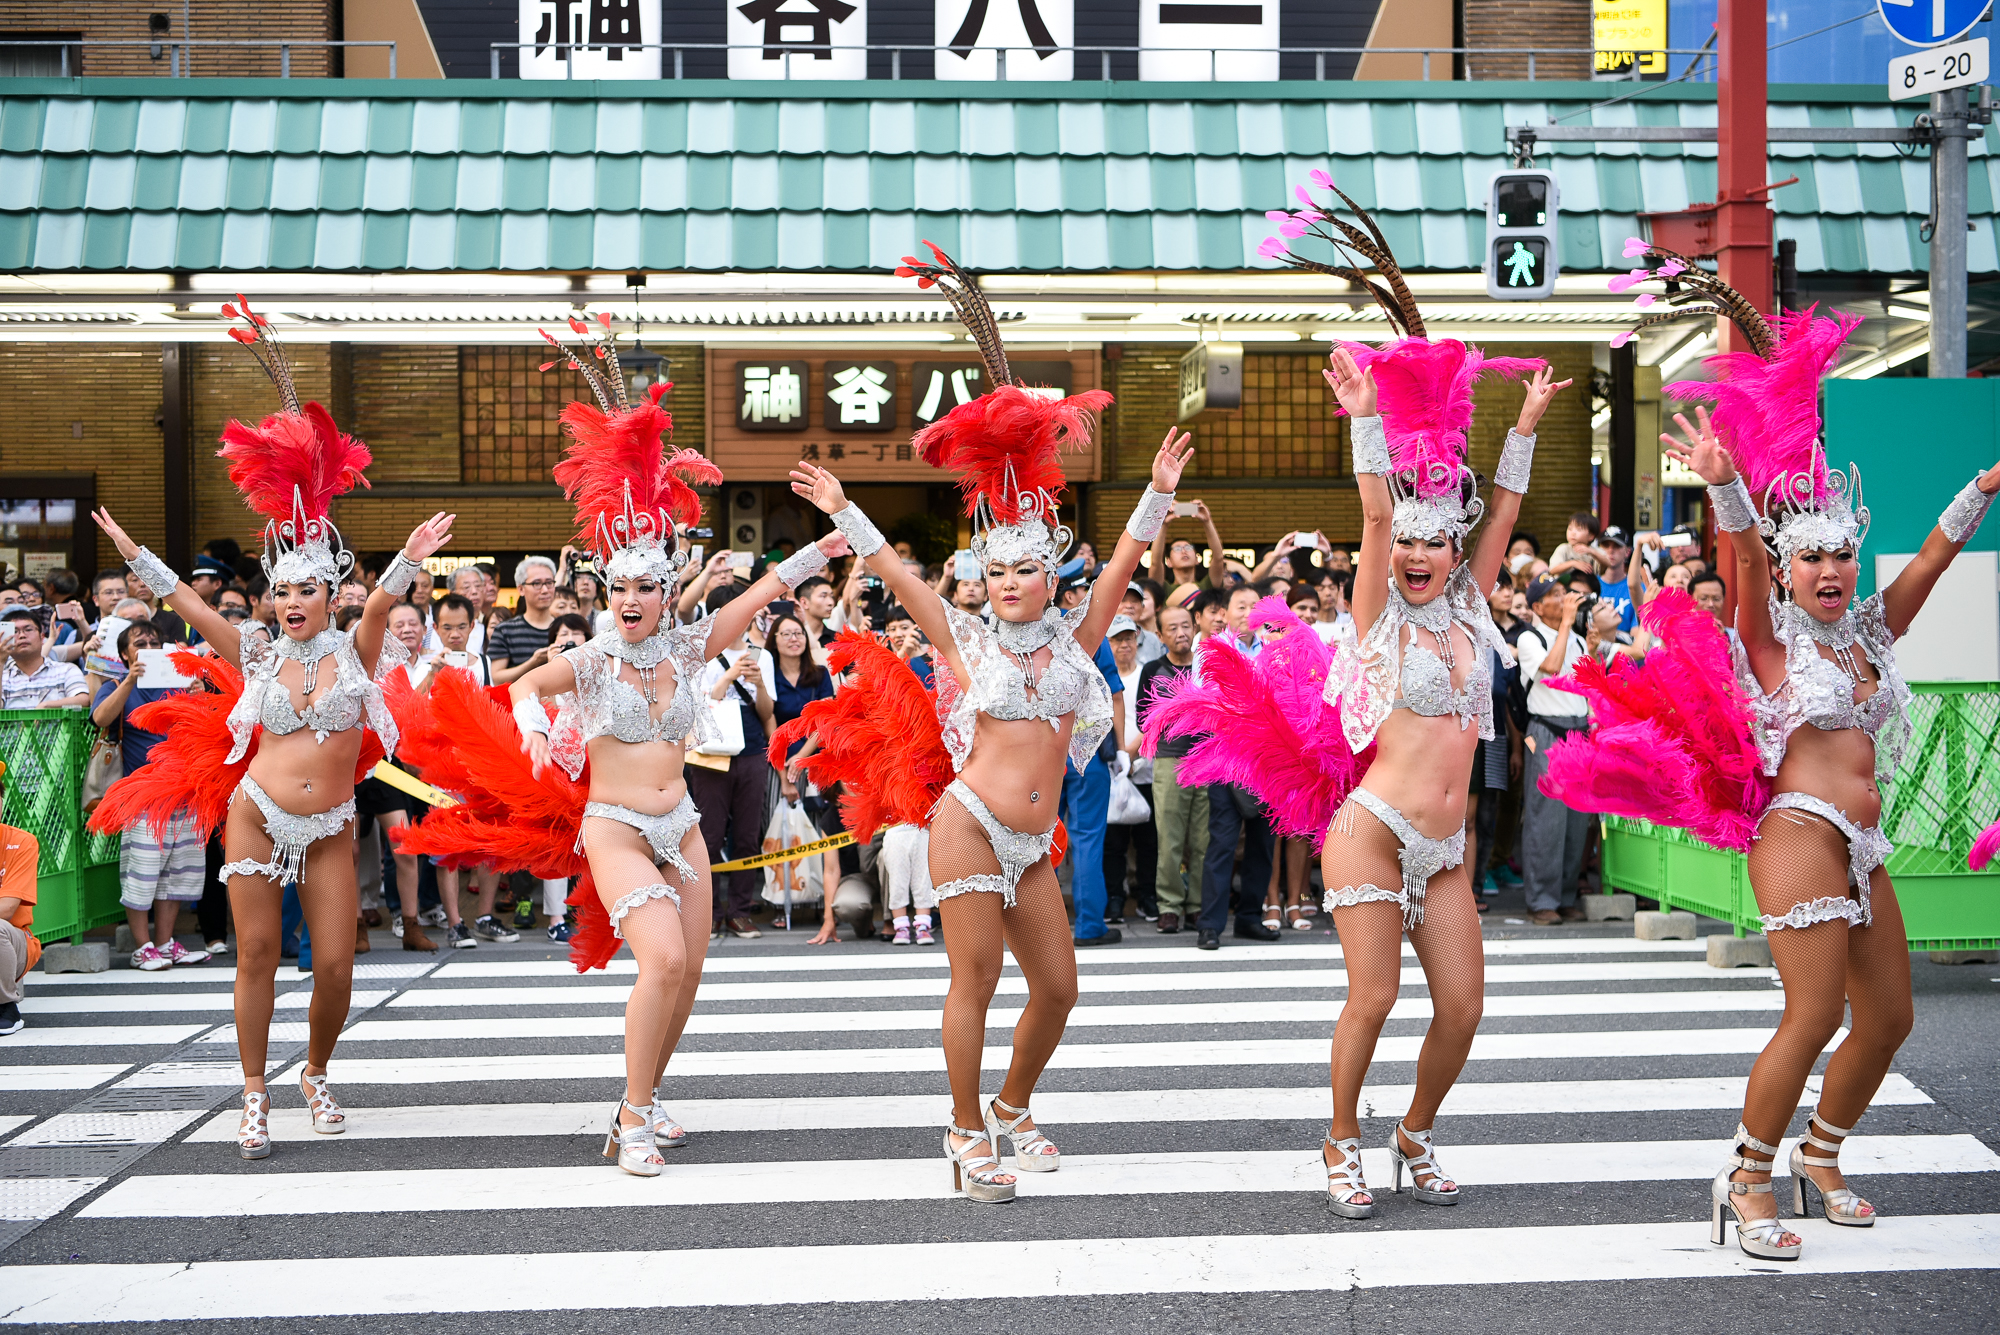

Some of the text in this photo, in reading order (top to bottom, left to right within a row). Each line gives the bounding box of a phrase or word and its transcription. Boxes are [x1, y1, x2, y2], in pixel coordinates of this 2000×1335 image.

[801, 443, 924, 461] 浅草一丁目
